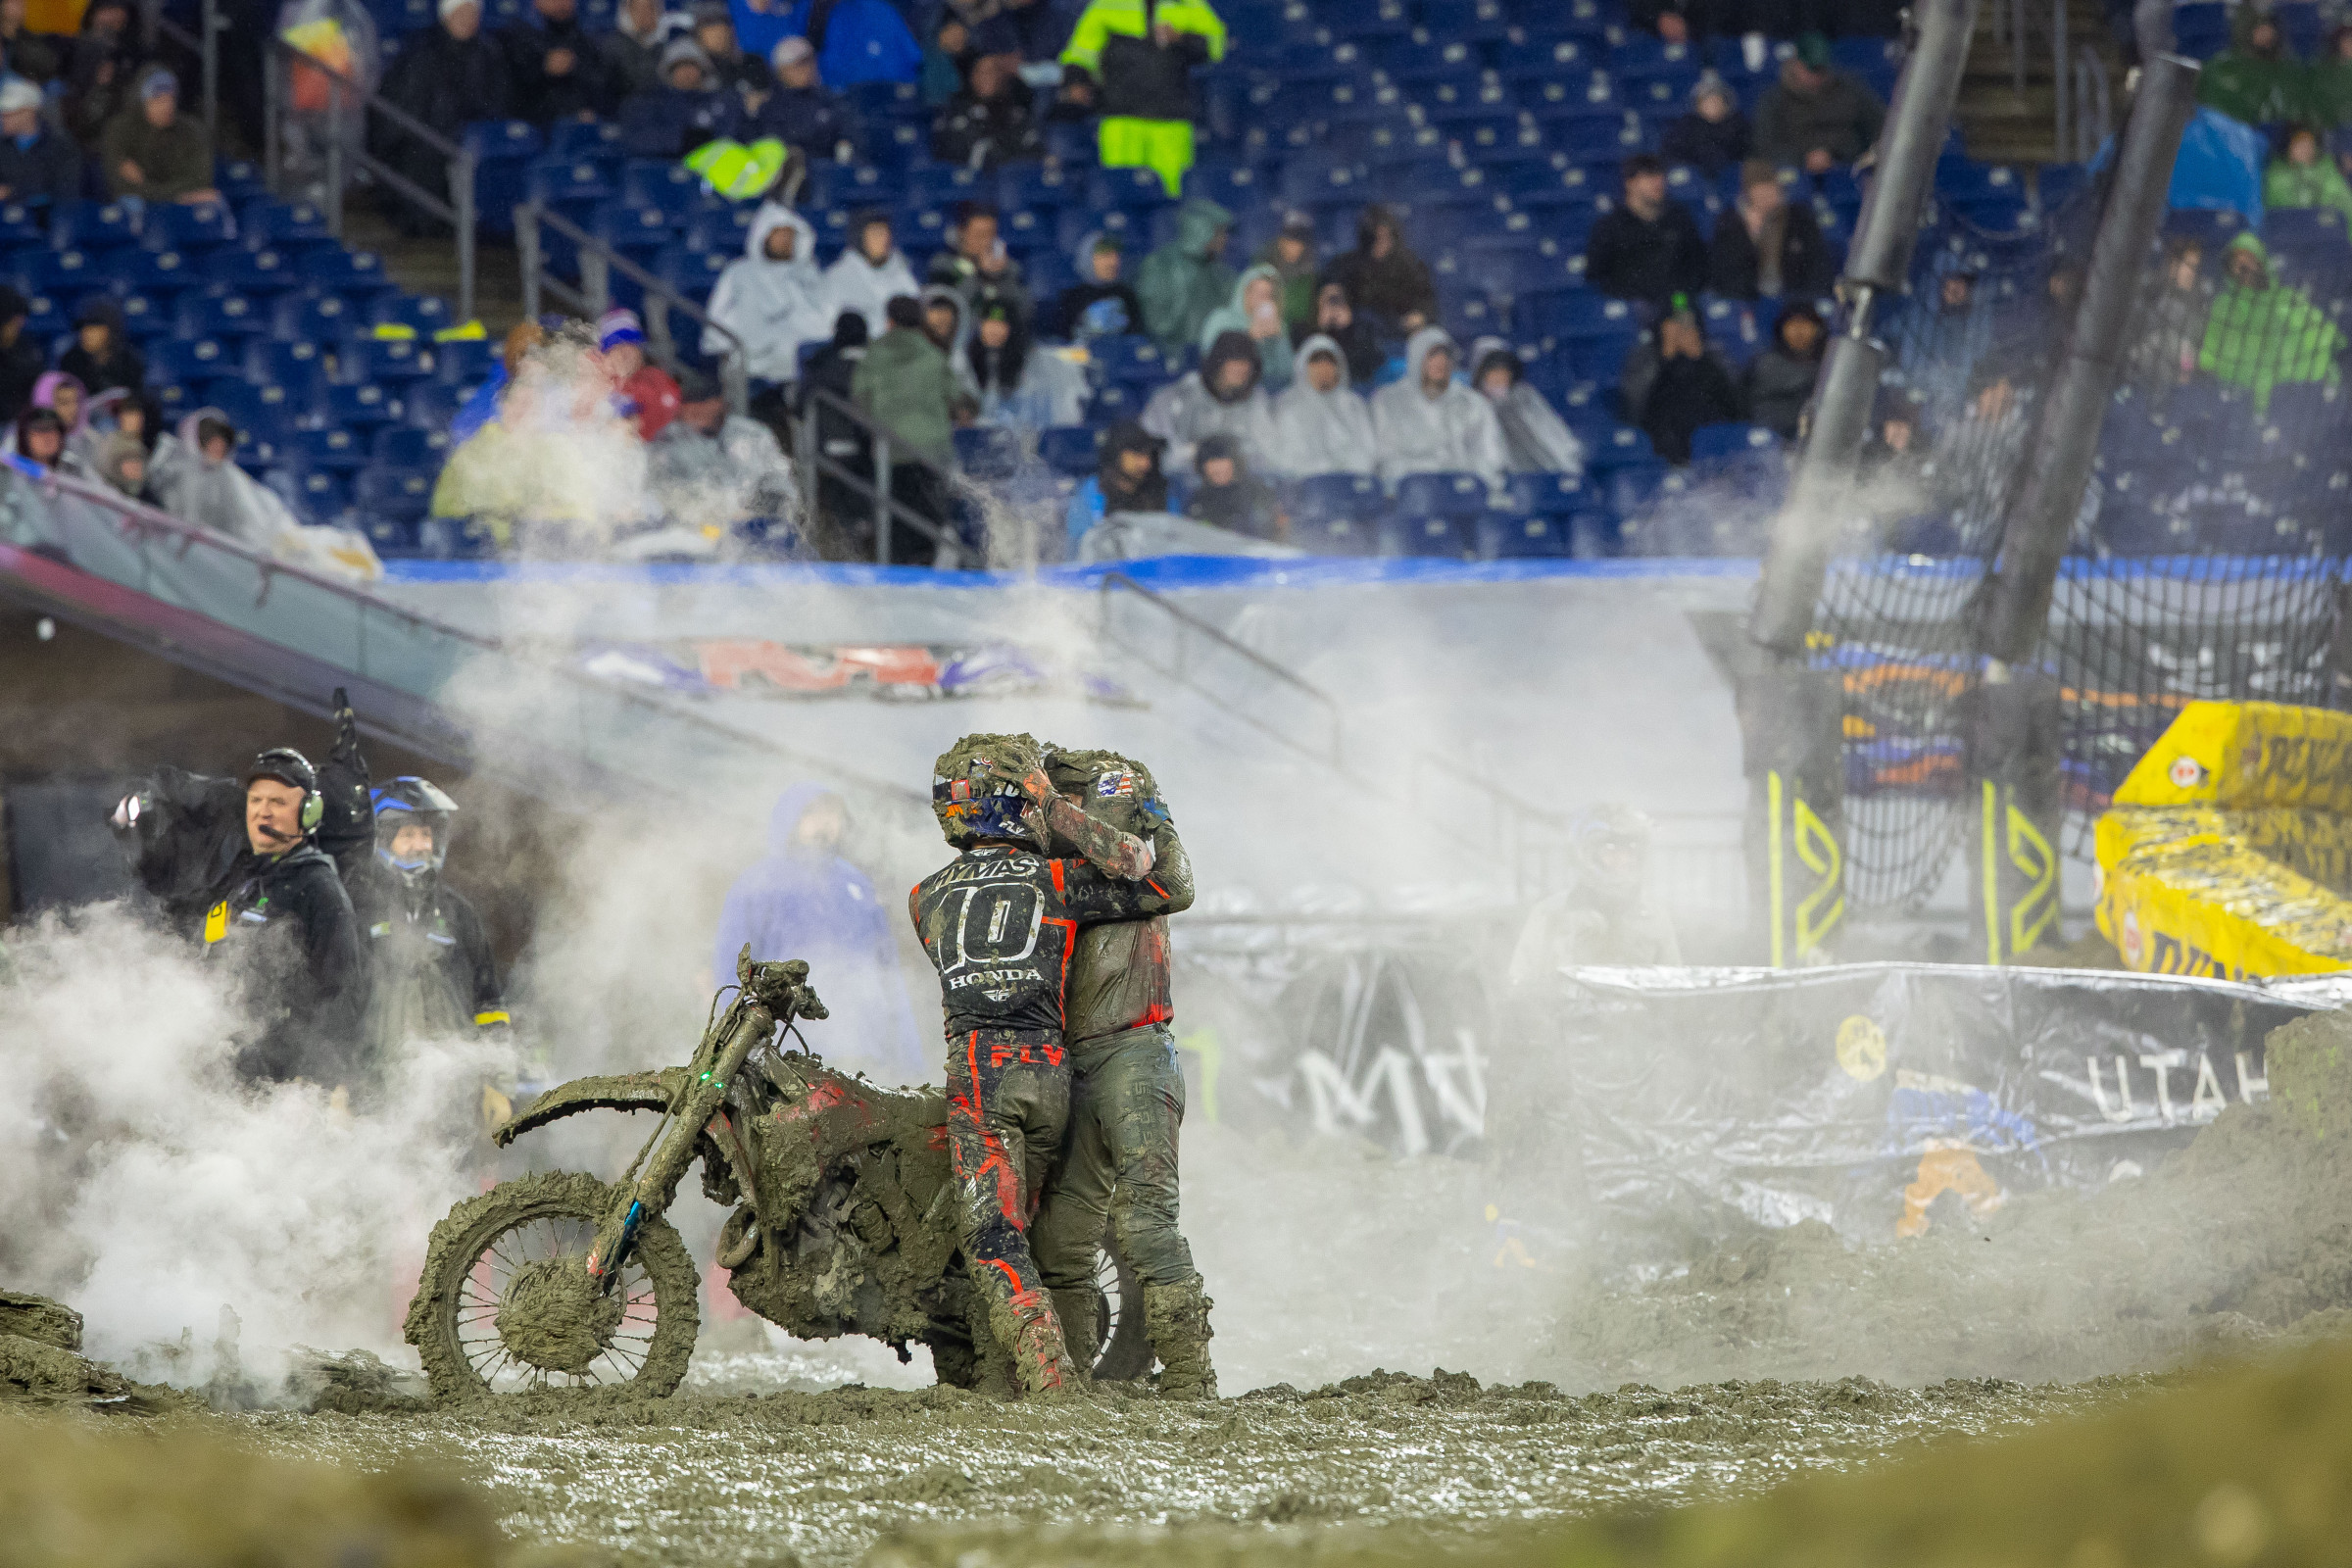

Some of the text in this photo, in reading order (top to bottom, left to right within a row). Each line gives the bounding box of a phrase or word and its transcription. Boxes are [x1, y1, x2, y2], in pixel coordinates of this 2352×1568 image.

[935, 882, 1046, 974] 10
[948, 968, 1045, 991] HONDA
[2085, 1051, 2271, 1128] UTAH
